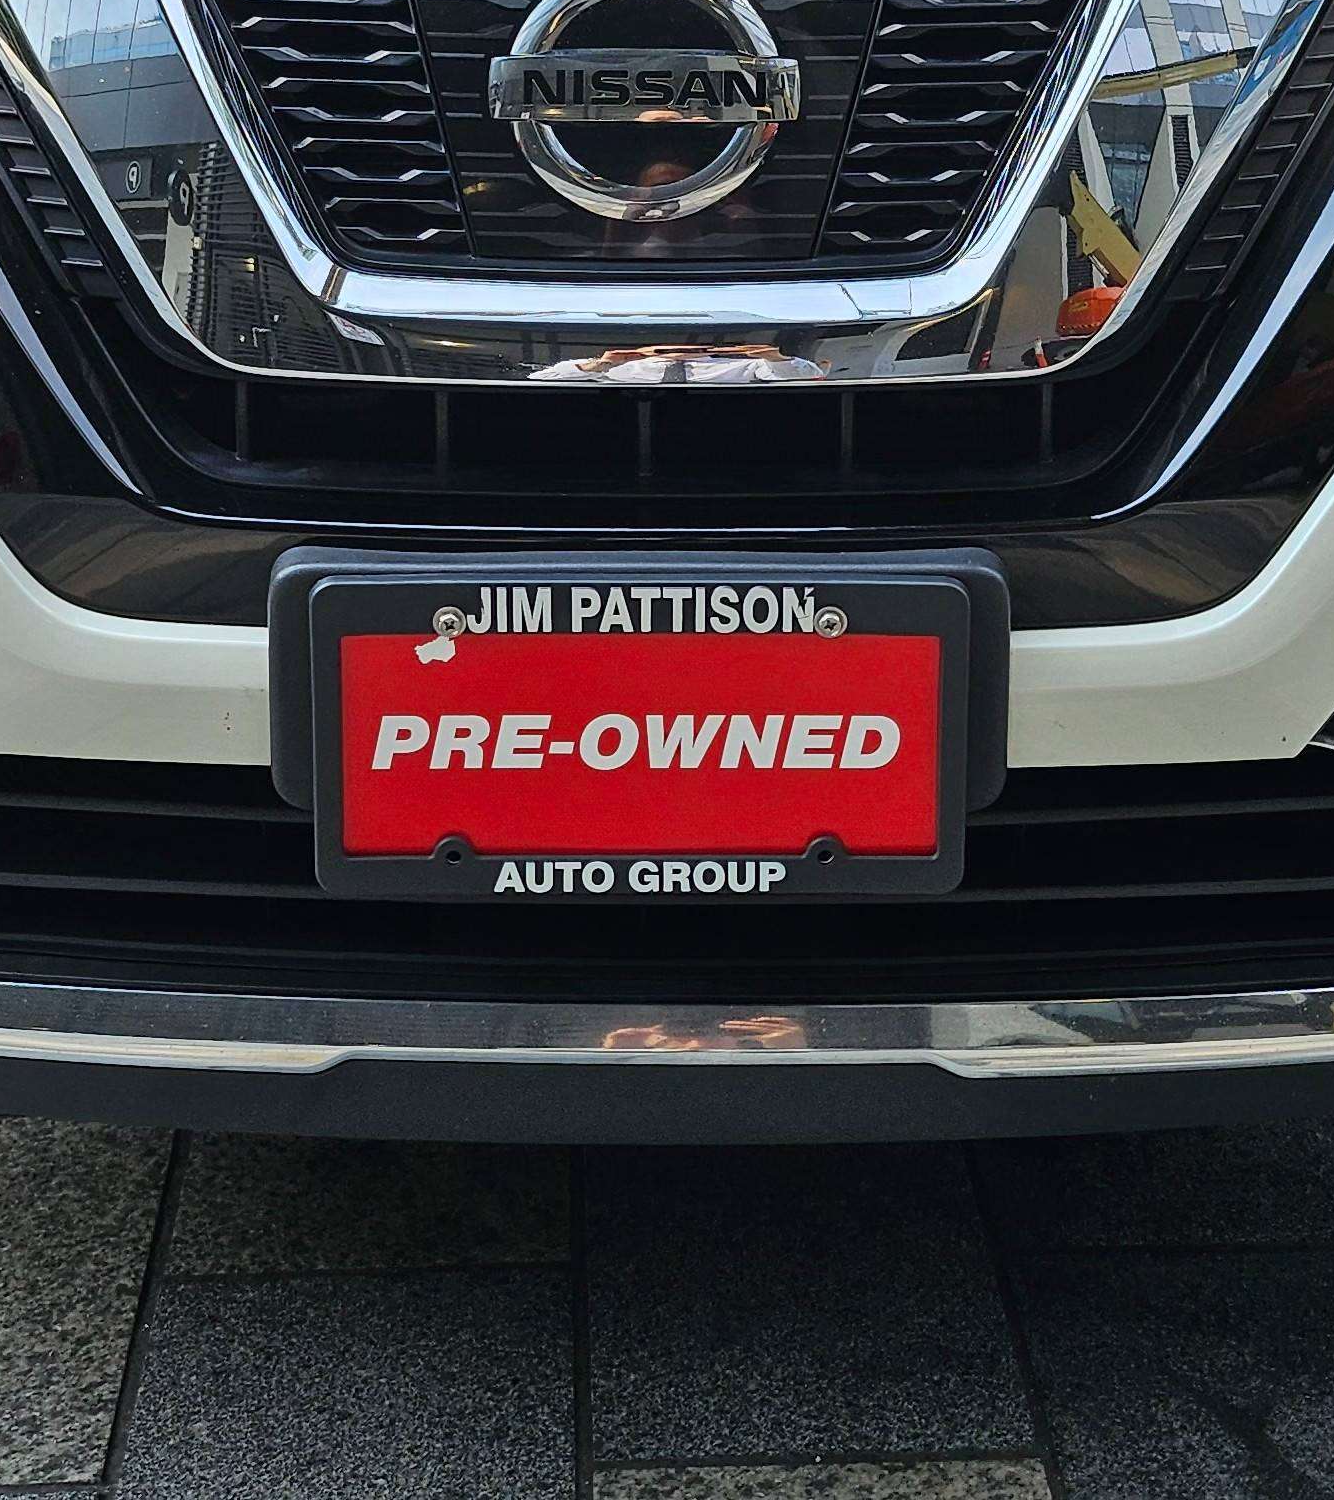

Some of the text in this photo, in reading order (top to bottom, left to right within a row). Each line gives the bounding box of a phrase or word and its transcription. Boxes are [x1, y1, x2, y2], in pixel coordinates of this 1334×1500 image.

[522, 69, 768, 107] NISSAN
[466, 586, 816, 635] JIM PATTISON
[370, 713, 902, 771] PRE-OWNED
[493, 860, 788, 895] AUTO GROUP
